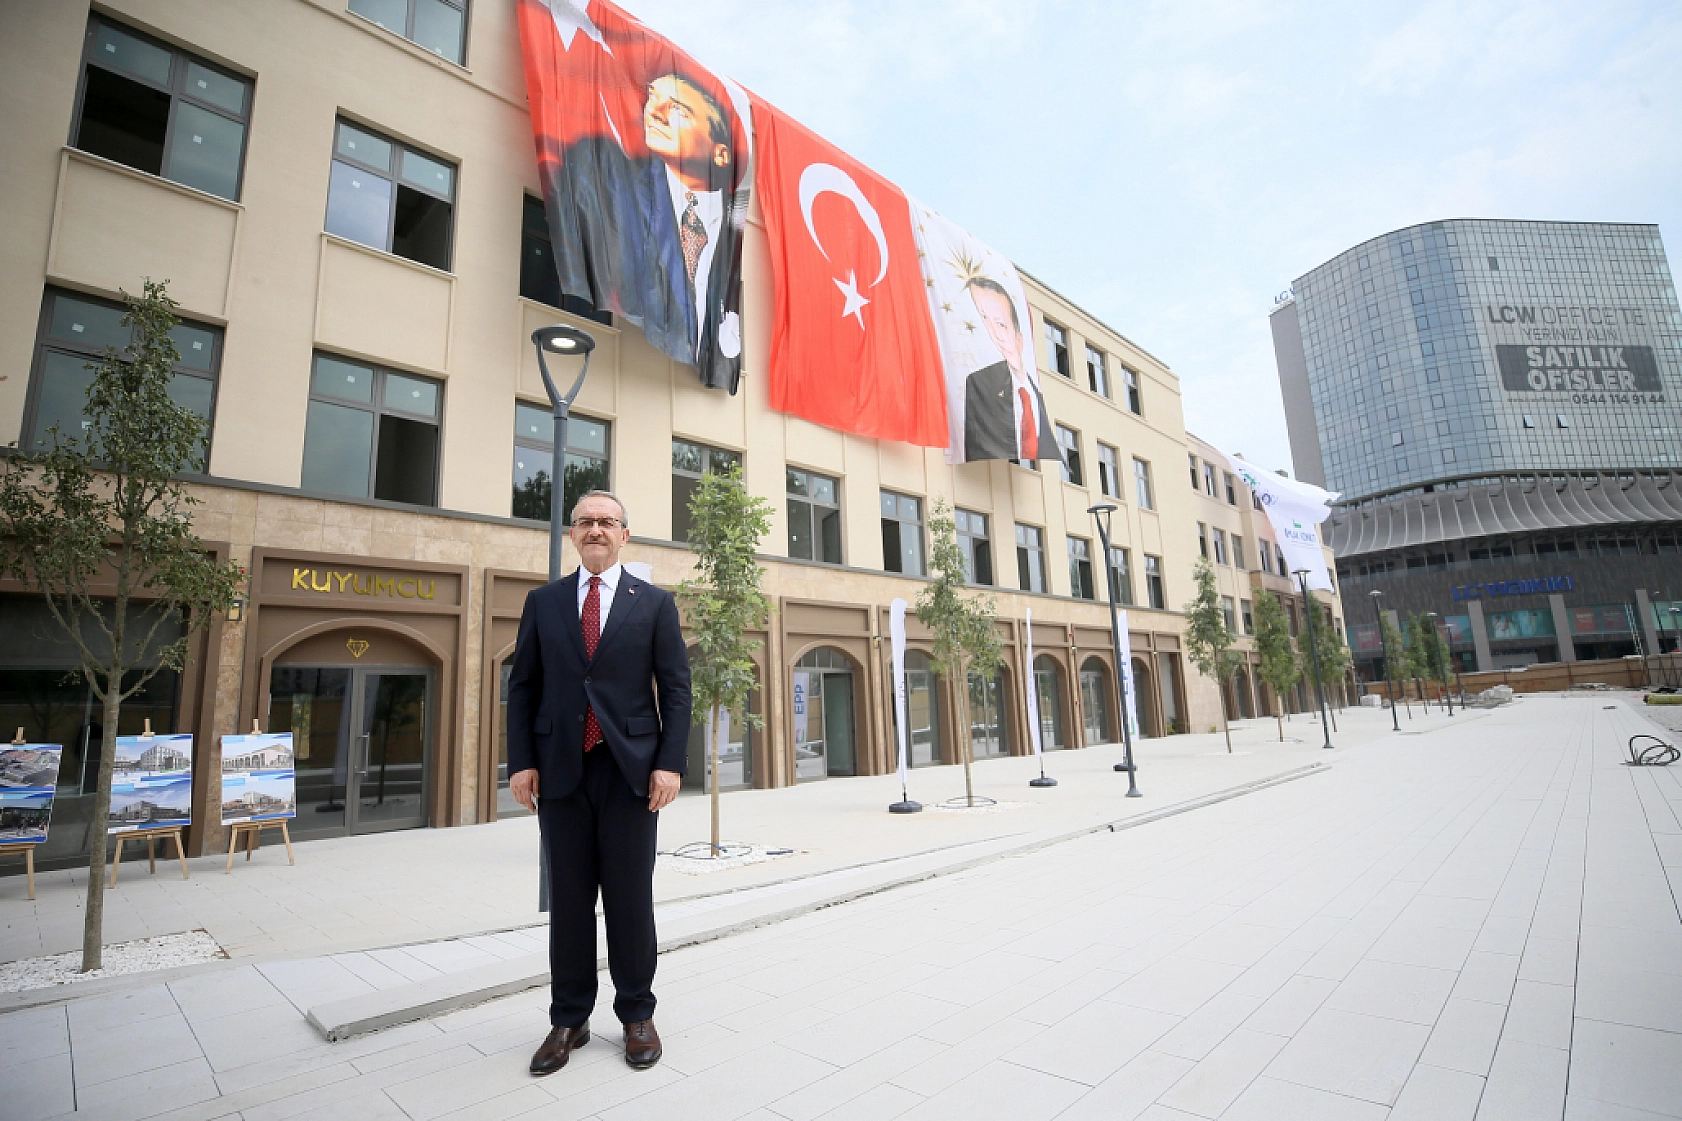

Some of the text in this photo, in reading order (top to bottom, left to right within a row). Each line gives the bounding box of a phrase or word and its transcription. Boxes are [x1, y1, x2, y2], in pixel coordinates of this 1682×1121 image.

[1488, 305, 1536, 324] LCW
[1526, 347, 1628, 368] SATILIK
[1528, 369, 1637, 391] OFİSLER
[1572, 393, 1607, 405] 0544
[1609, 394, 1630, 405] 114
[1632, 395, 1646, 405] 91
[1649, 395, 1666, 405] 44
[291, 568, 435, 599] KUYUMCU
[1452, 583, 1481, 599] LC
[794, 684, 805, 715] EPP
